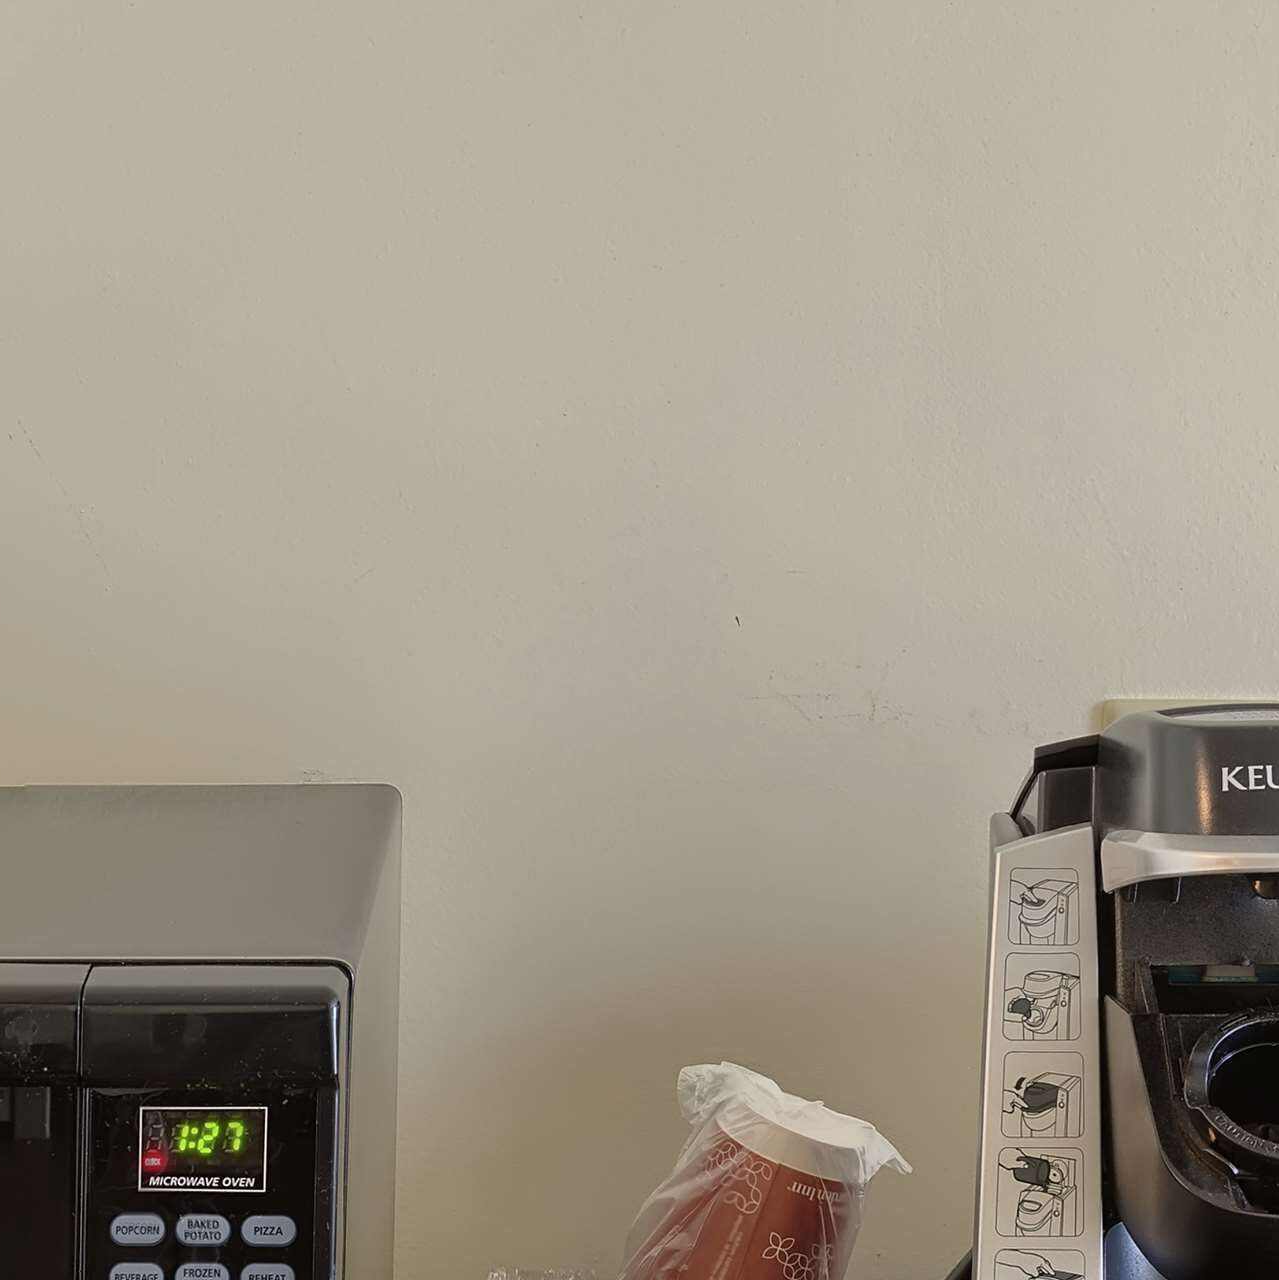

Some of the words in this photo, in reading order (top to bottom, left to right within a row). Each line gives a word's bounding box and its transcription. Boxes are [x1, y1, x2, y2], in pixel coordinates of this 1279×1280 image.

[178, 1121, 244, 1153] 1:27
[148, 1176, 219, 1187] MICROWAVE
[222, 1177, 256, 1187] OVEN
[115, 1225, 160, 1235] POPCORN
[187, 1220, 220, 1230] BAKED
[184, 1231, 222, 1241] POTATO
[253, 1226, 284, 1236] PIZZA
[183, 1268, 221, 1278] FROZEN
